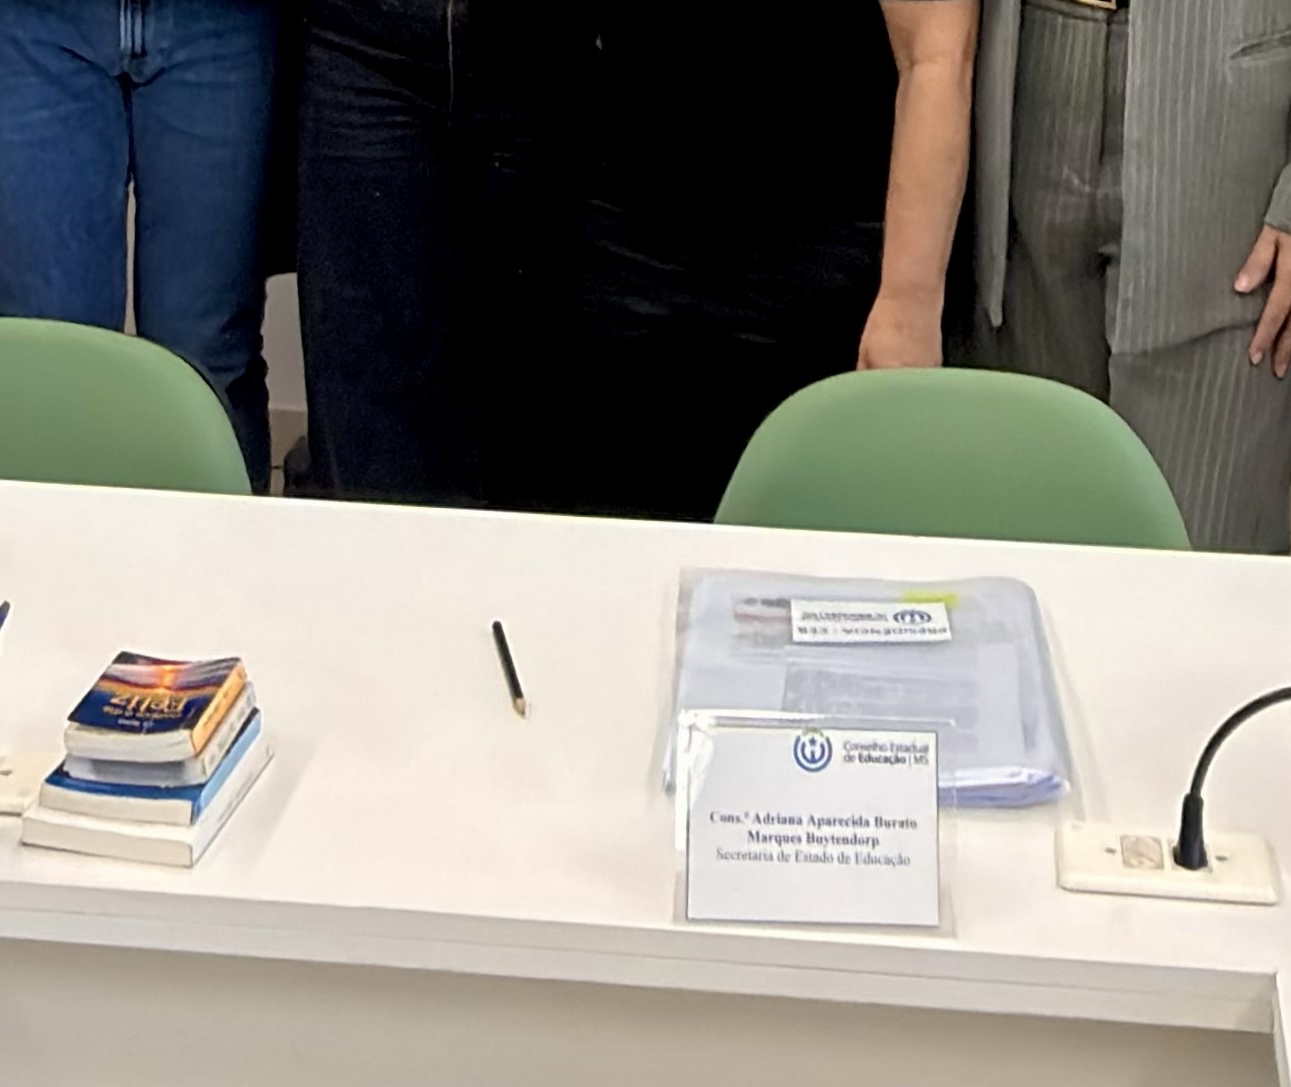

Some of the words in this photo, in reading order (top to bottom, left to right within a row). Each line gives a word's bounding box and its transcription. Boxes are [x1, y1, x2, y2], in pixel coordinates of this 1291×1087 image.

[858, 752, 907, 765] Educação
[752, 811, 803, 826] Adriana
[808, 814, 870, 830] Aparecida
[748, 830, 803, 847] Marques
[716, 847, 774, 862] Secretaria
[777, 851, 791, 863] de
[795, 850, 834, 864] Estado
[837, 852, 851, 865] de
[855, 852, 911, 868] Educação
